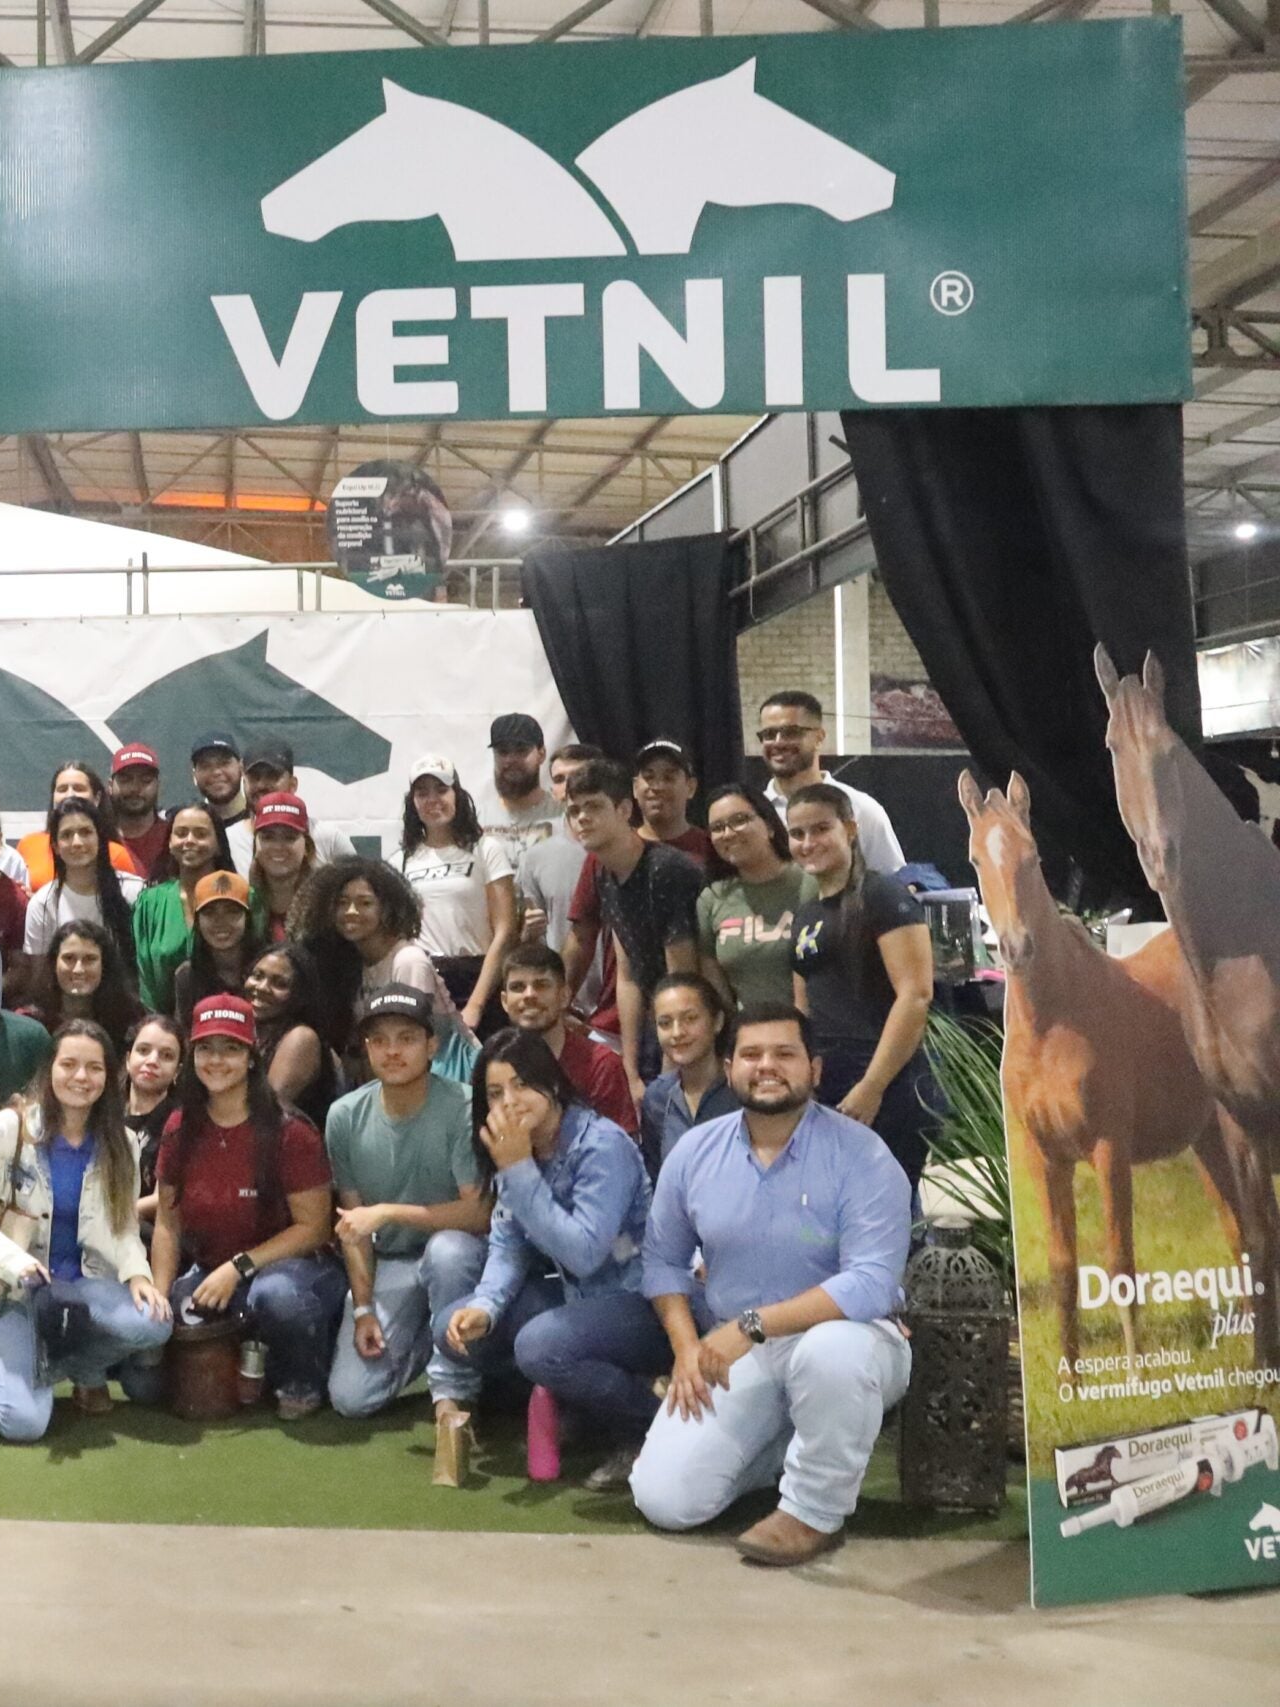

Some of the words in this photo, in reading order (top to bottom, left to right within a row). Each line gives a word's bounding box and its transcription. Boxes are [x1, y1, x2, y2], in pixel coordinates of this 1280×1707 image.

[210, 273, 942, 421] VETNIL
[719, 910, 795, 945] FILA
[1078, 1252, 1254, 1310] Doraequi
[1209, 1300, 1256, 1350] plus
[1057, 1355, 1071, 1375] A
[1074, 1353, 1131, 1376] espera
[1135, 1347, 1195, 1371] acabou.
[1059, 1382, 1073, 1403] O
[1077, 1375, 1172, 1400] vermífugo
[1174, 1367, 1225, 1392] Vetnil
[1128, 1427, 1193, 1459] Doraequi
[1132, 1470, 1185, 1499] Doraequi
